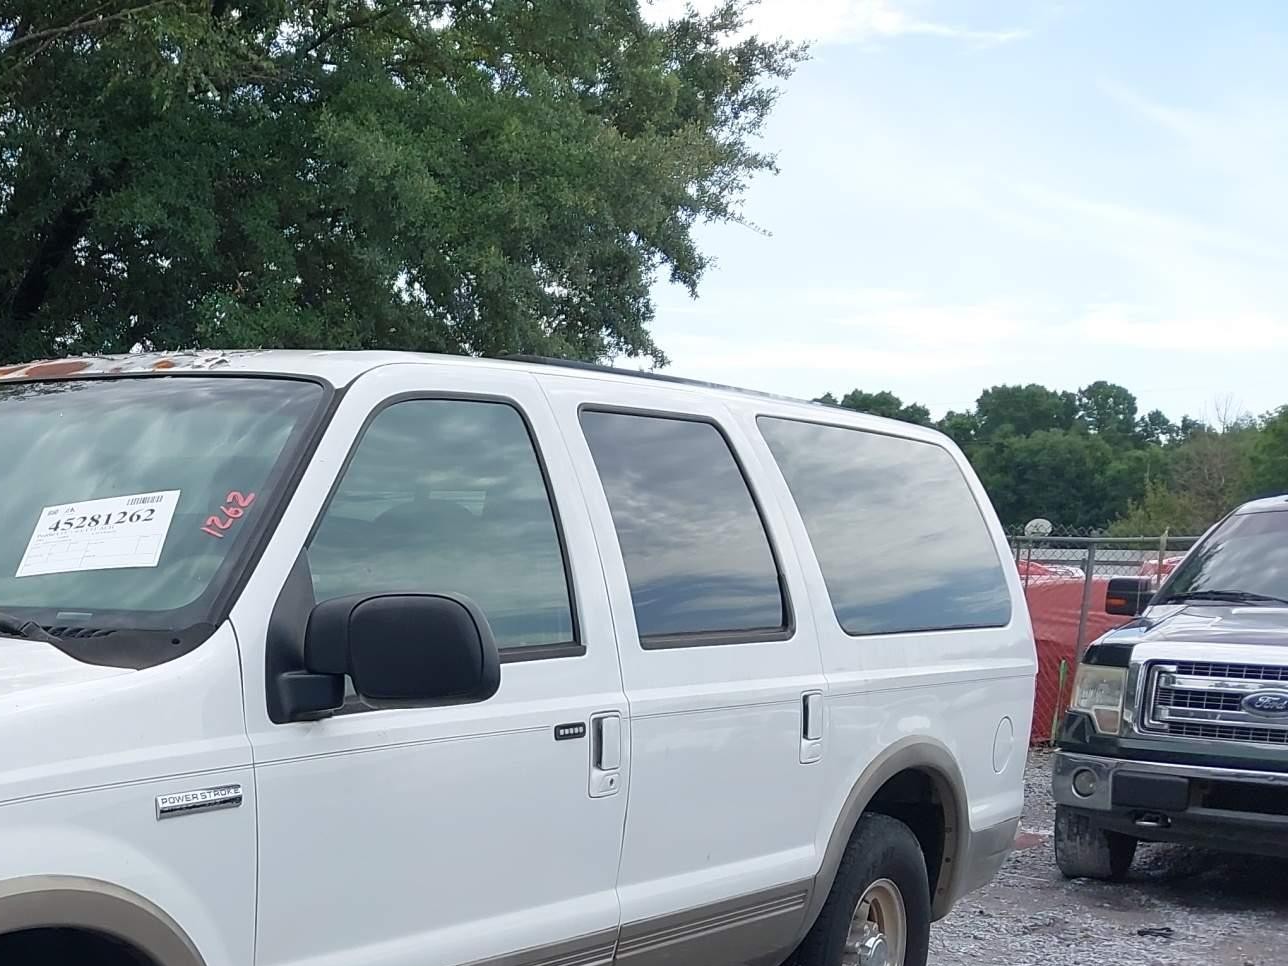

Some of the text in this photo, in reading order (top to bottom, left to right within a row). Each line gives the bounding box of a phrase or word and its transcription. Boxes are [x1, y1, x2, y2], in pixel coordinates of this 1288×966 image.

[48, 508, 155, 532] 45281262
[200, 491, 255, 538] 1262
[160, 787, 241, 806] POWER STROKE
